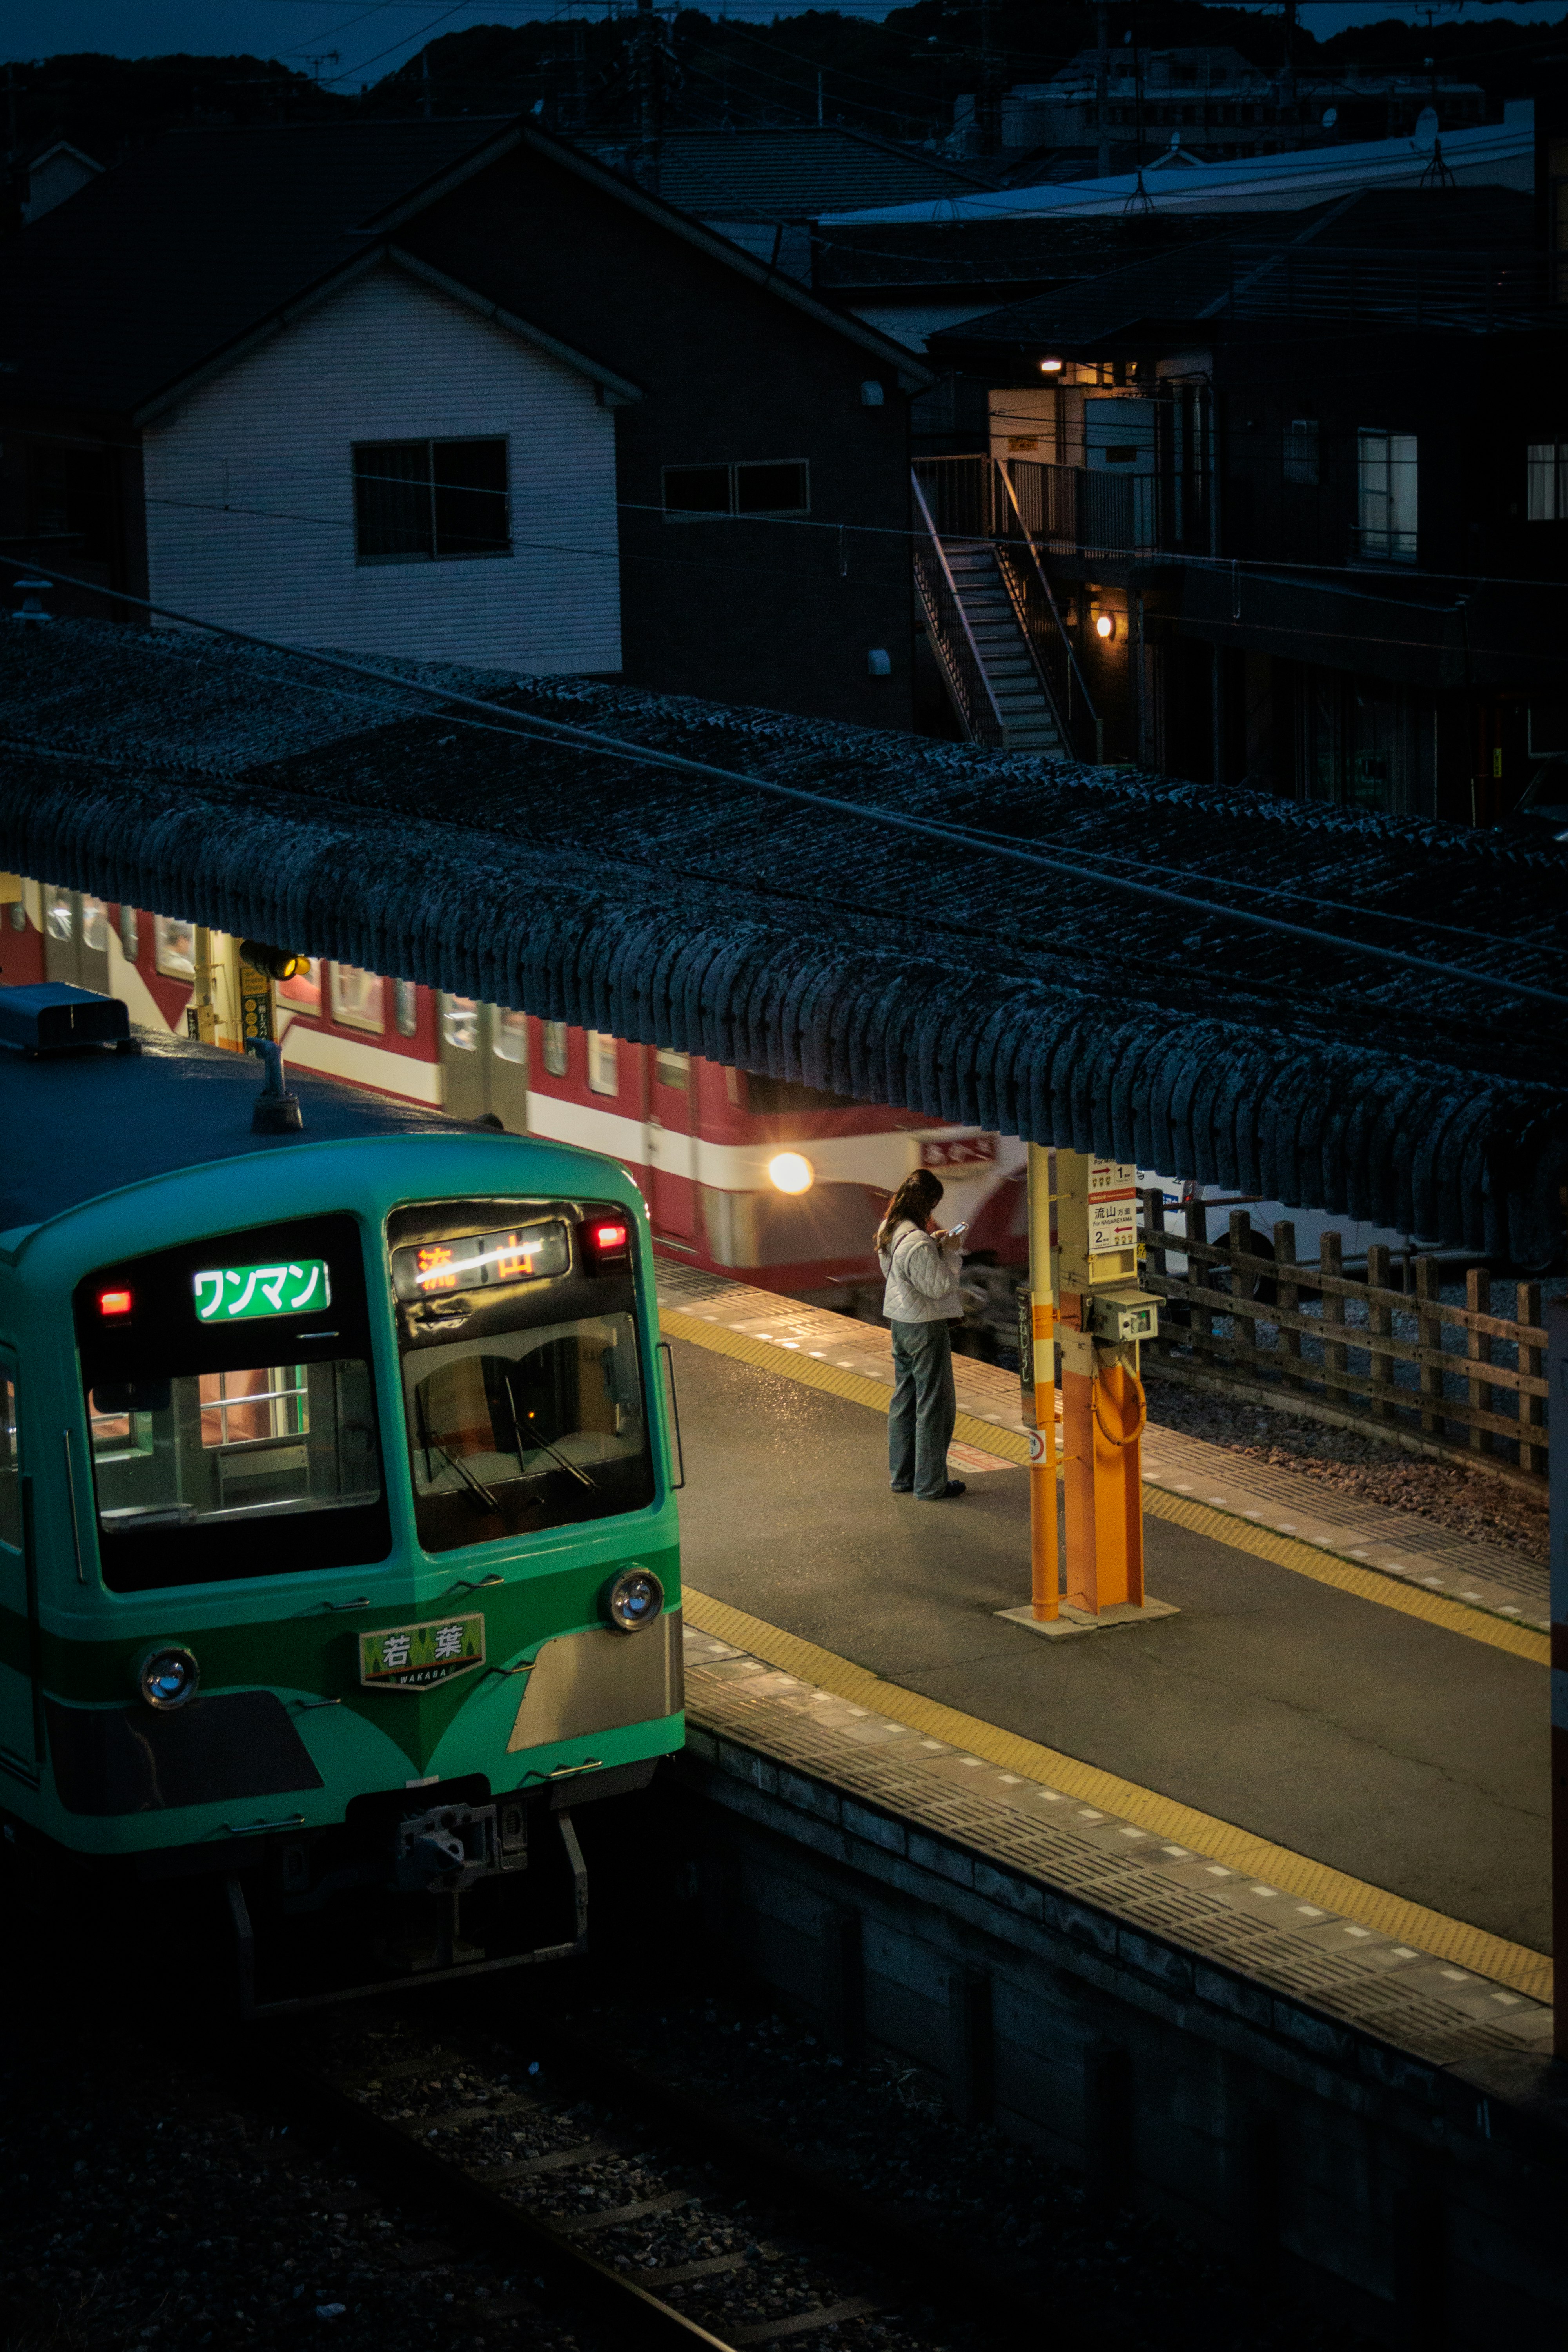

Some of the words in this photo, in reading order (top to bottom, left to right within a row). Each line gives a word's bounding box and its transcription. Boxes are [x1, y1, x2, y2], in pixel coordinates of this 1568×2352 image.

[1094, 1206, 1131, 1219] 流山方面
[1101, 1216, 1132, 1225] NAGAREYAMA
[418, 1235, 533, 1290] 流山
[194, 1264, 319, 1318] ワンマン
[383, 1624, 464, 1668] 若葉
[400, 1668, 446, 1684] WAKABA
